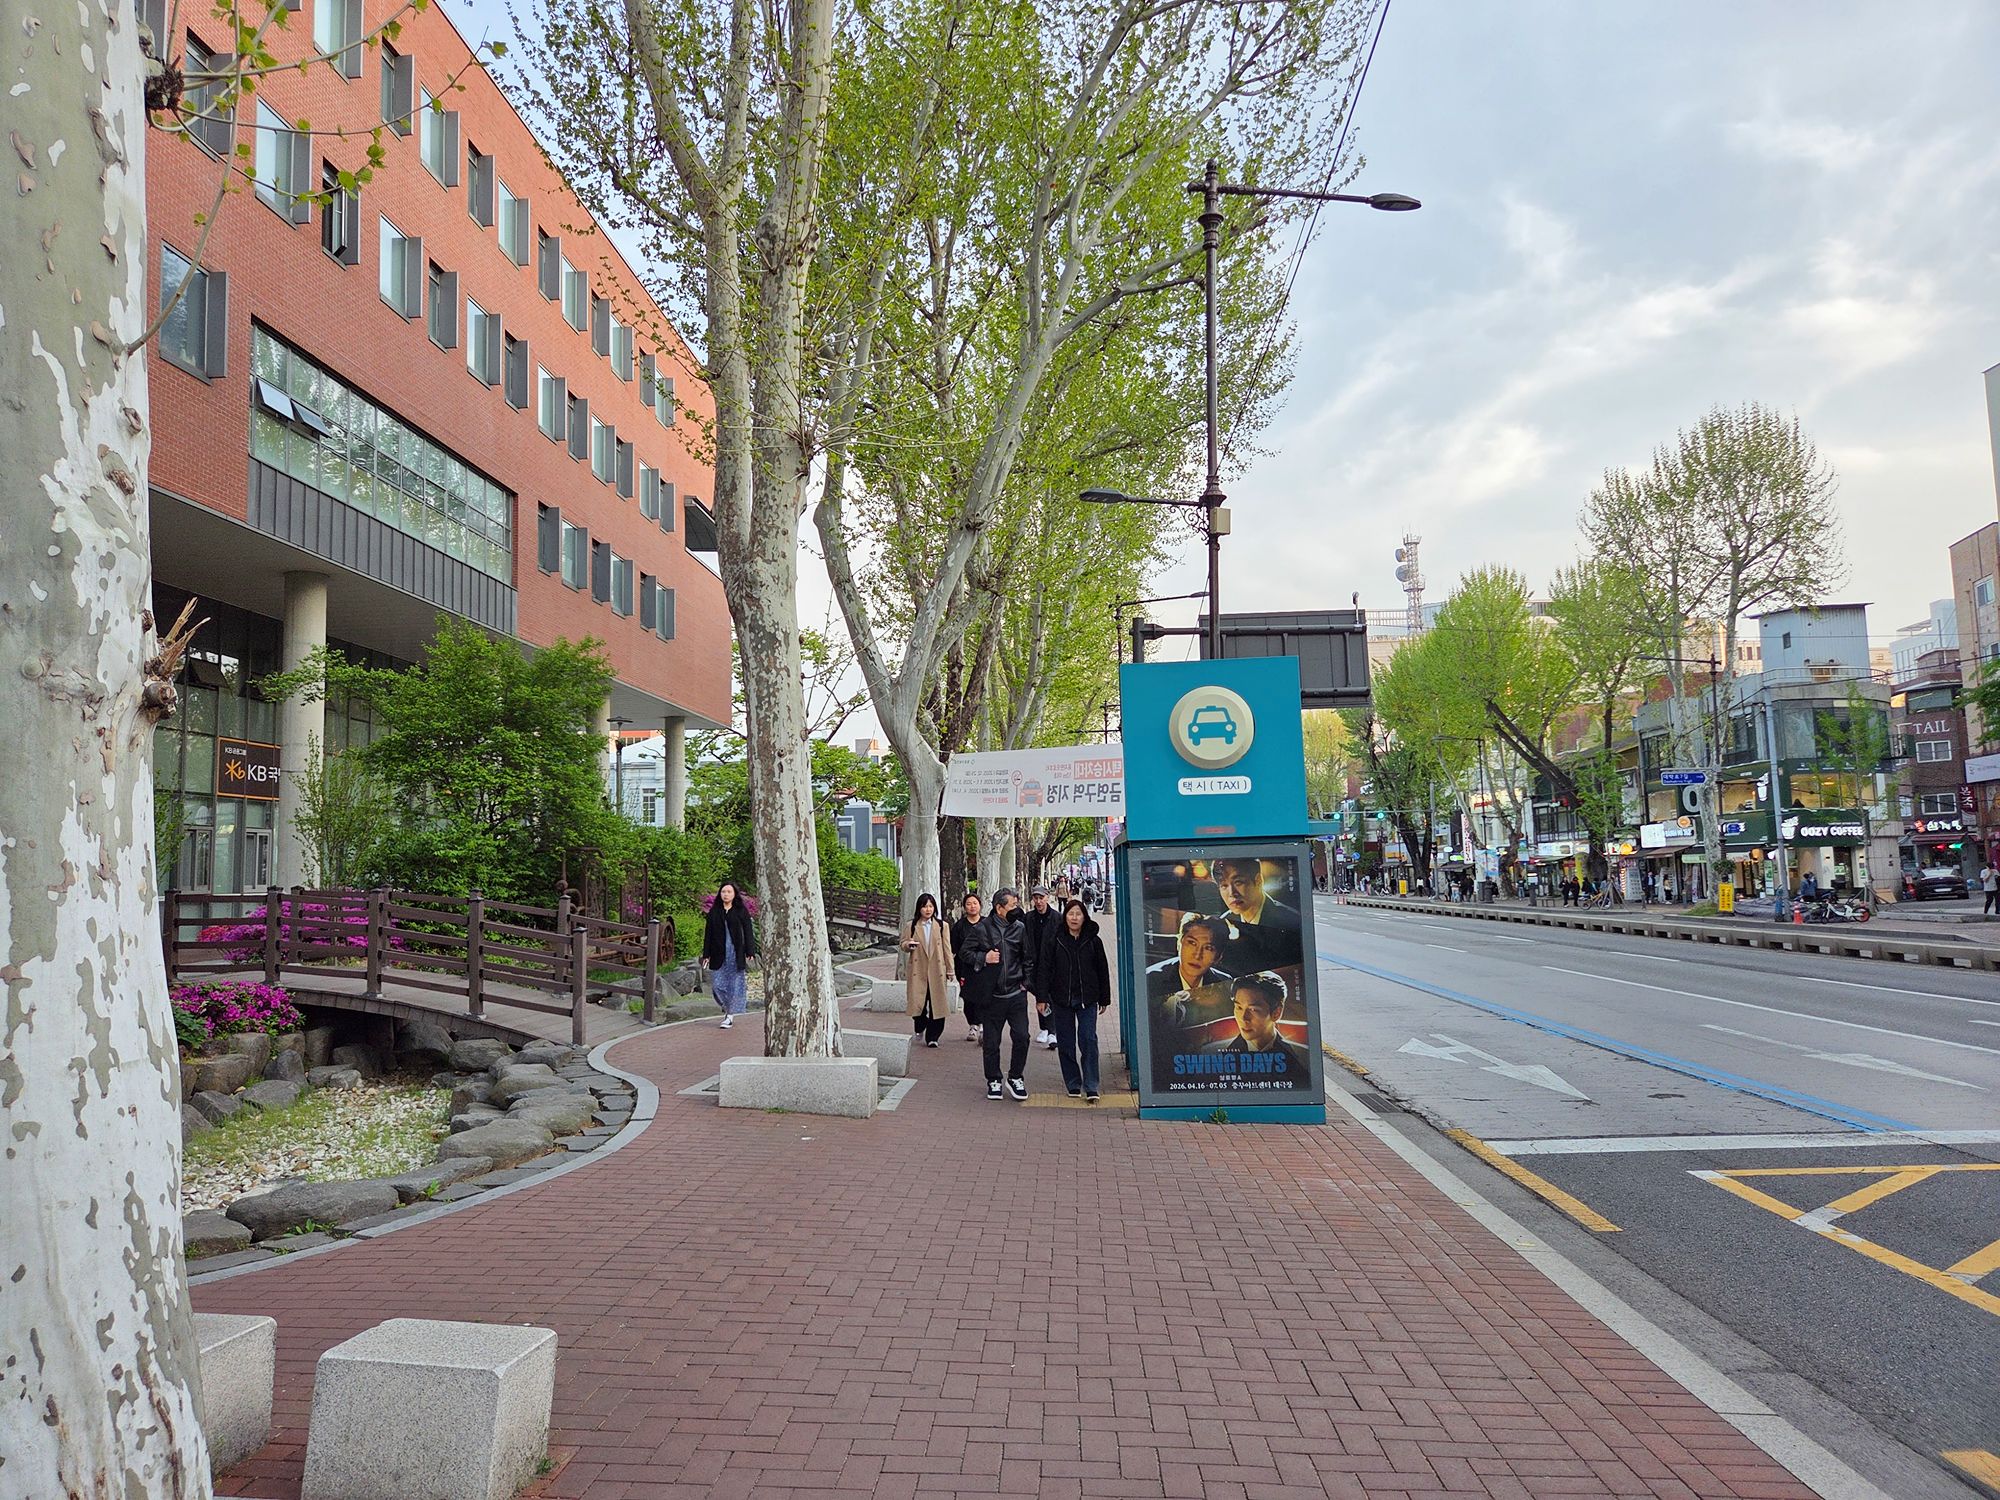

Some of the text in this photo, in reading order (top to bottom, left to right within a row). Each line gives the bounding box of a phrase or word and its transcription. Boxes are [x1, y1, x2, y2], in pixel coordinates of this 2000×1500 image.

[1913, 720, 1950, 735] TAIL
[247, 763, 281, 783] KB국
[1830, 826, 1865, 836] COFFEE
[1173, 1052, 1287, 1075] SWING DAYS
